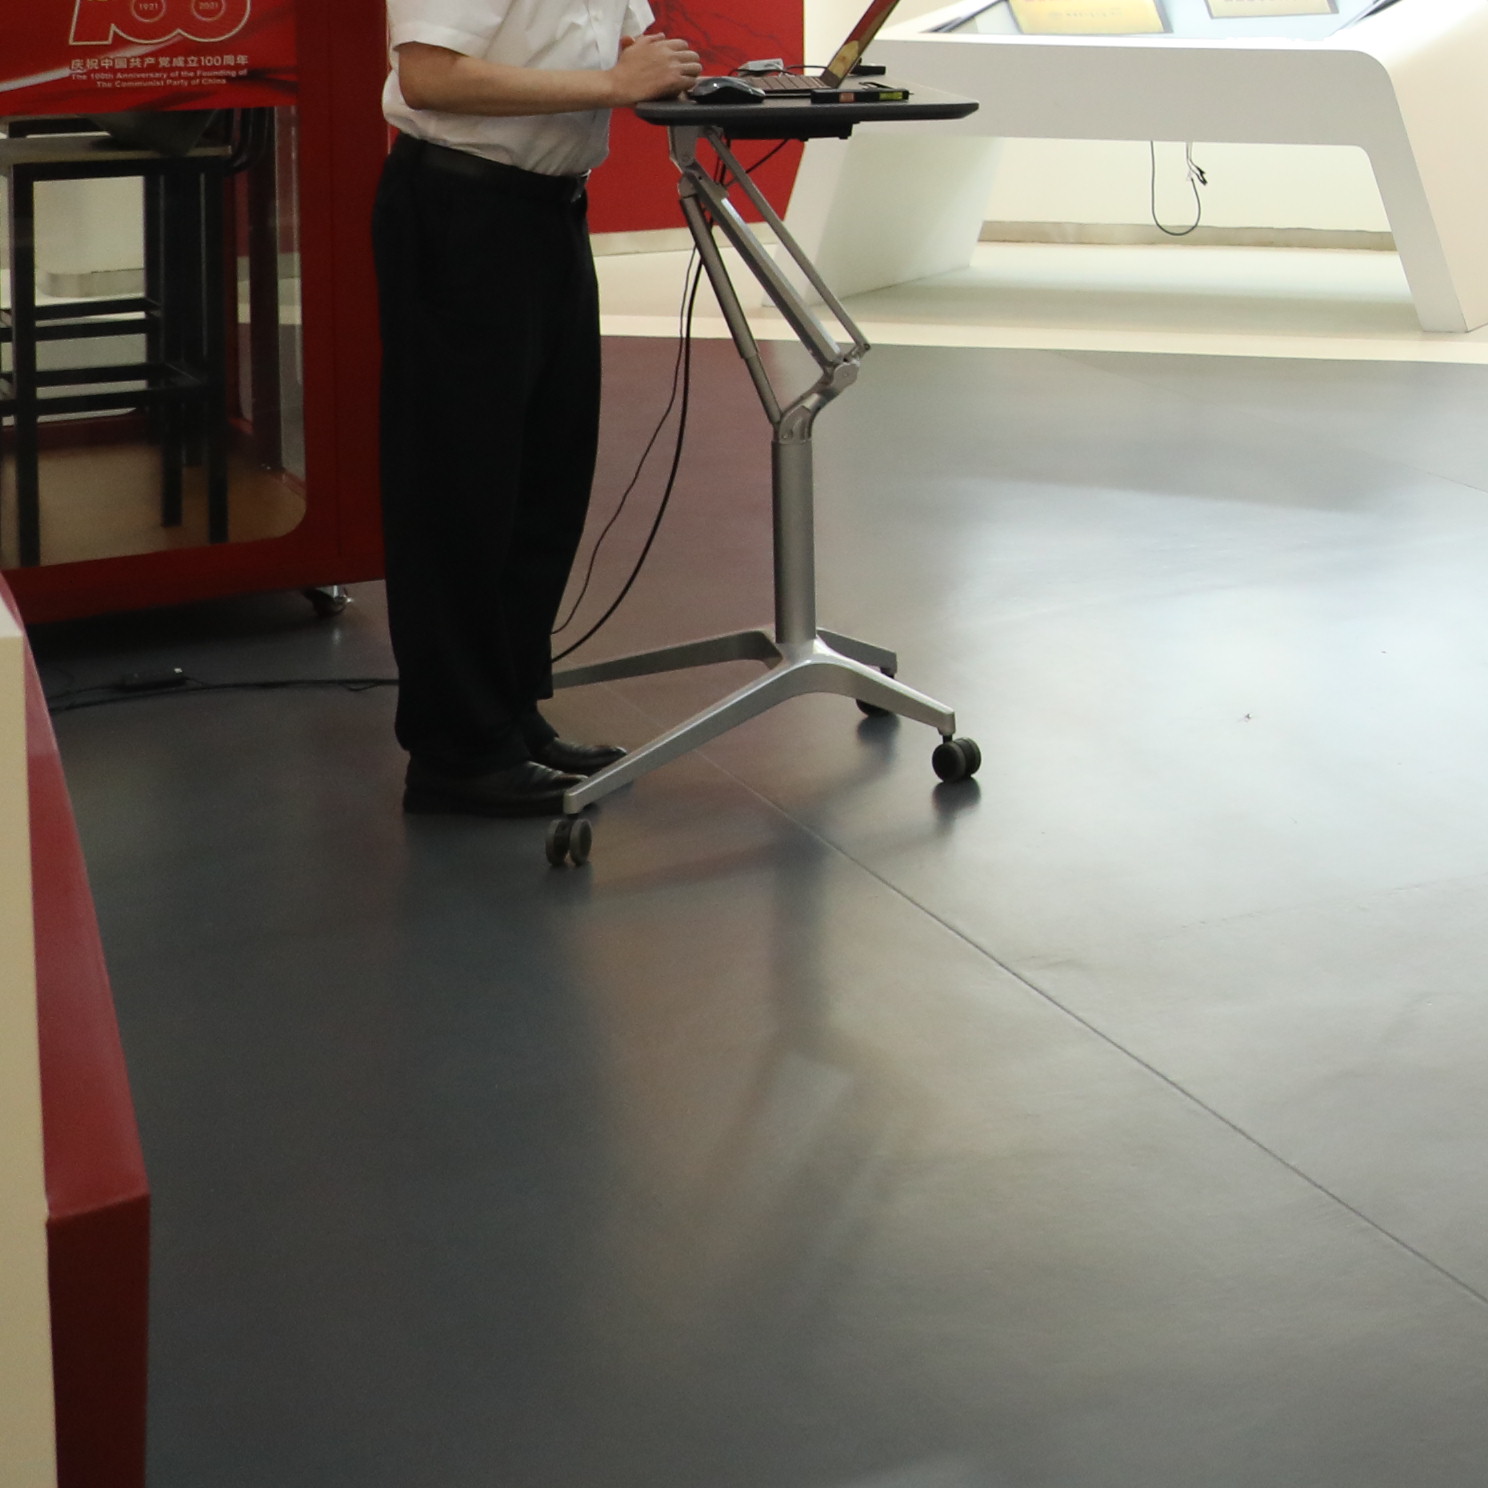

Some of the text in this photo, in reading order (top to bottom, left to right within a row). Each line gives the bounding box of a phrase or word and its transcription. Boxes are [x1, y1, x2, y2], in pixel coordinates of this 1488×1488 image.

[70, 55, 249, 71] 庆祝中国共产党成立100周年
